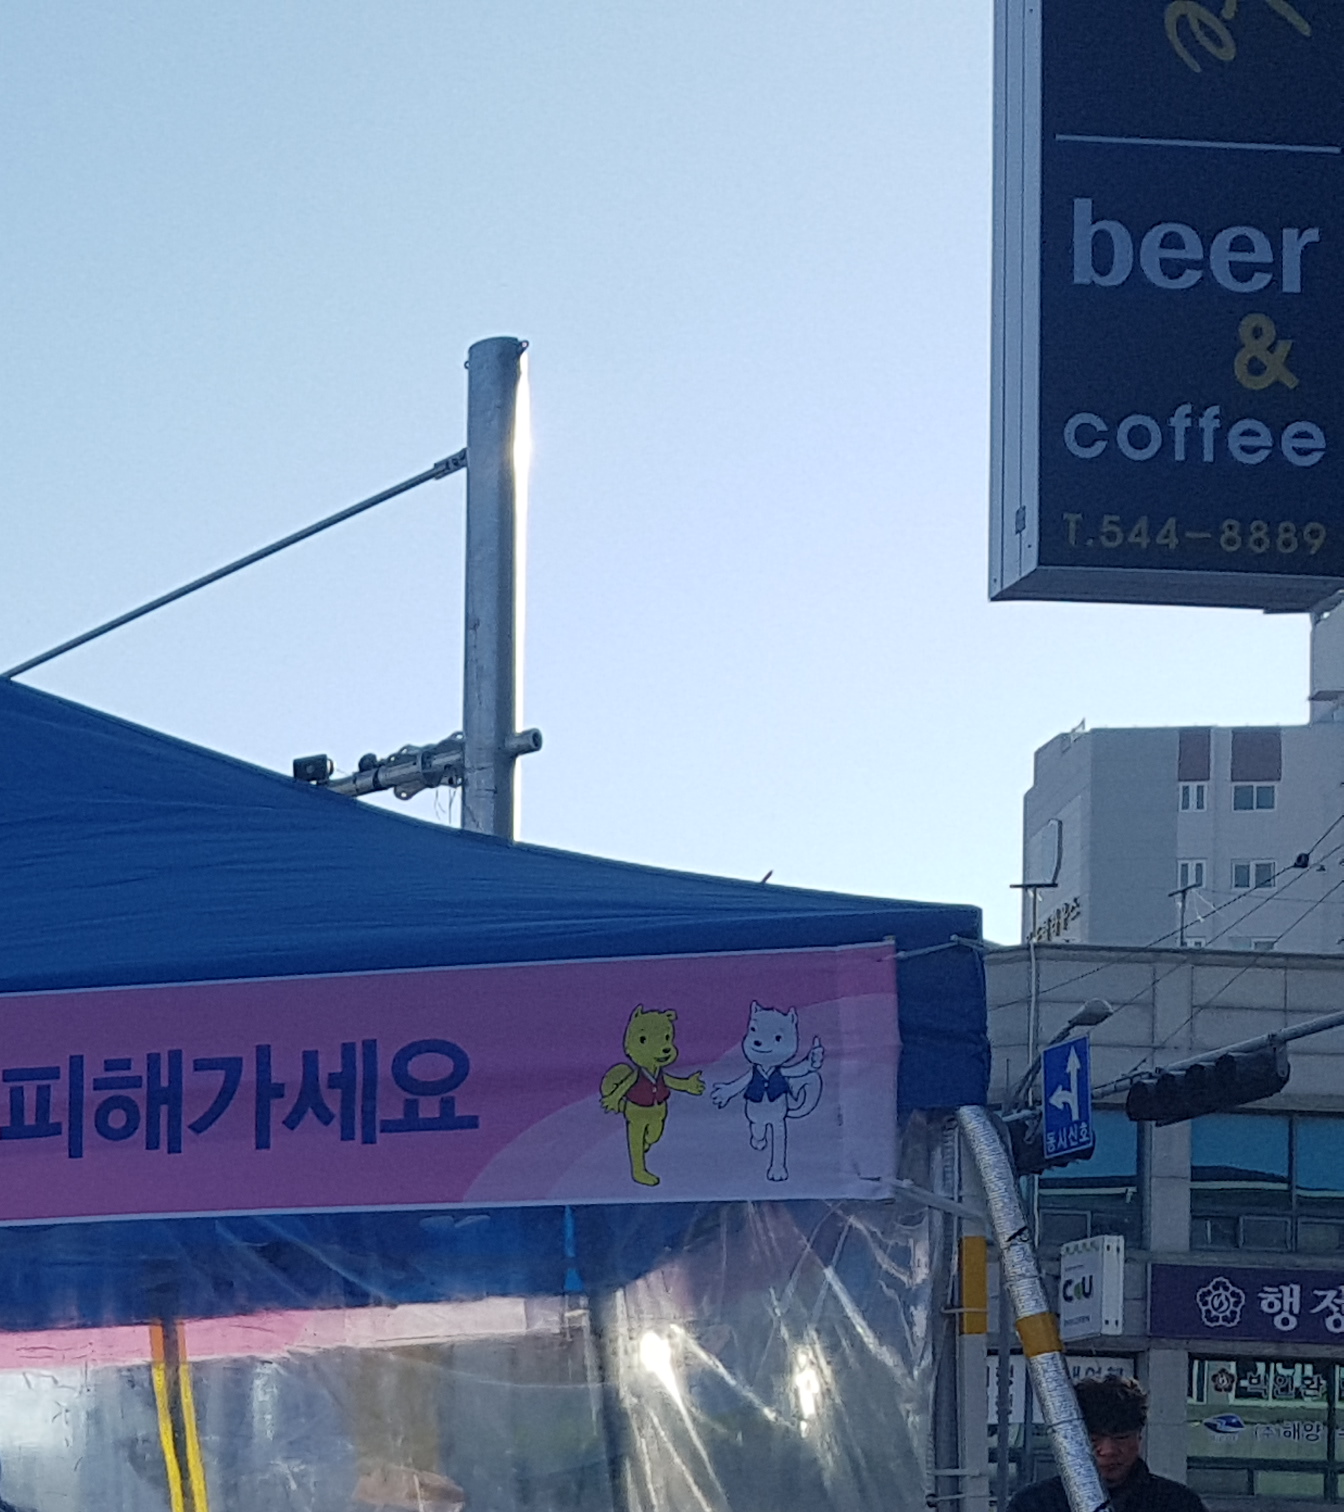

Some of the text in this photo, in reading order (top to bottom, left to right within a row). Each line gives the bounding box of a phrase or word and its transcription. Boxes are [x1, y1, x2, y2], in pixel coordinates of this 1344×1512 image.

[1073, 198, 1320, 294] beer
[1234, 313, 1300, 390] &
[1063, 402, 1327, 467] coffee
[1047, 1121, 1089, 1153] 동시신호
